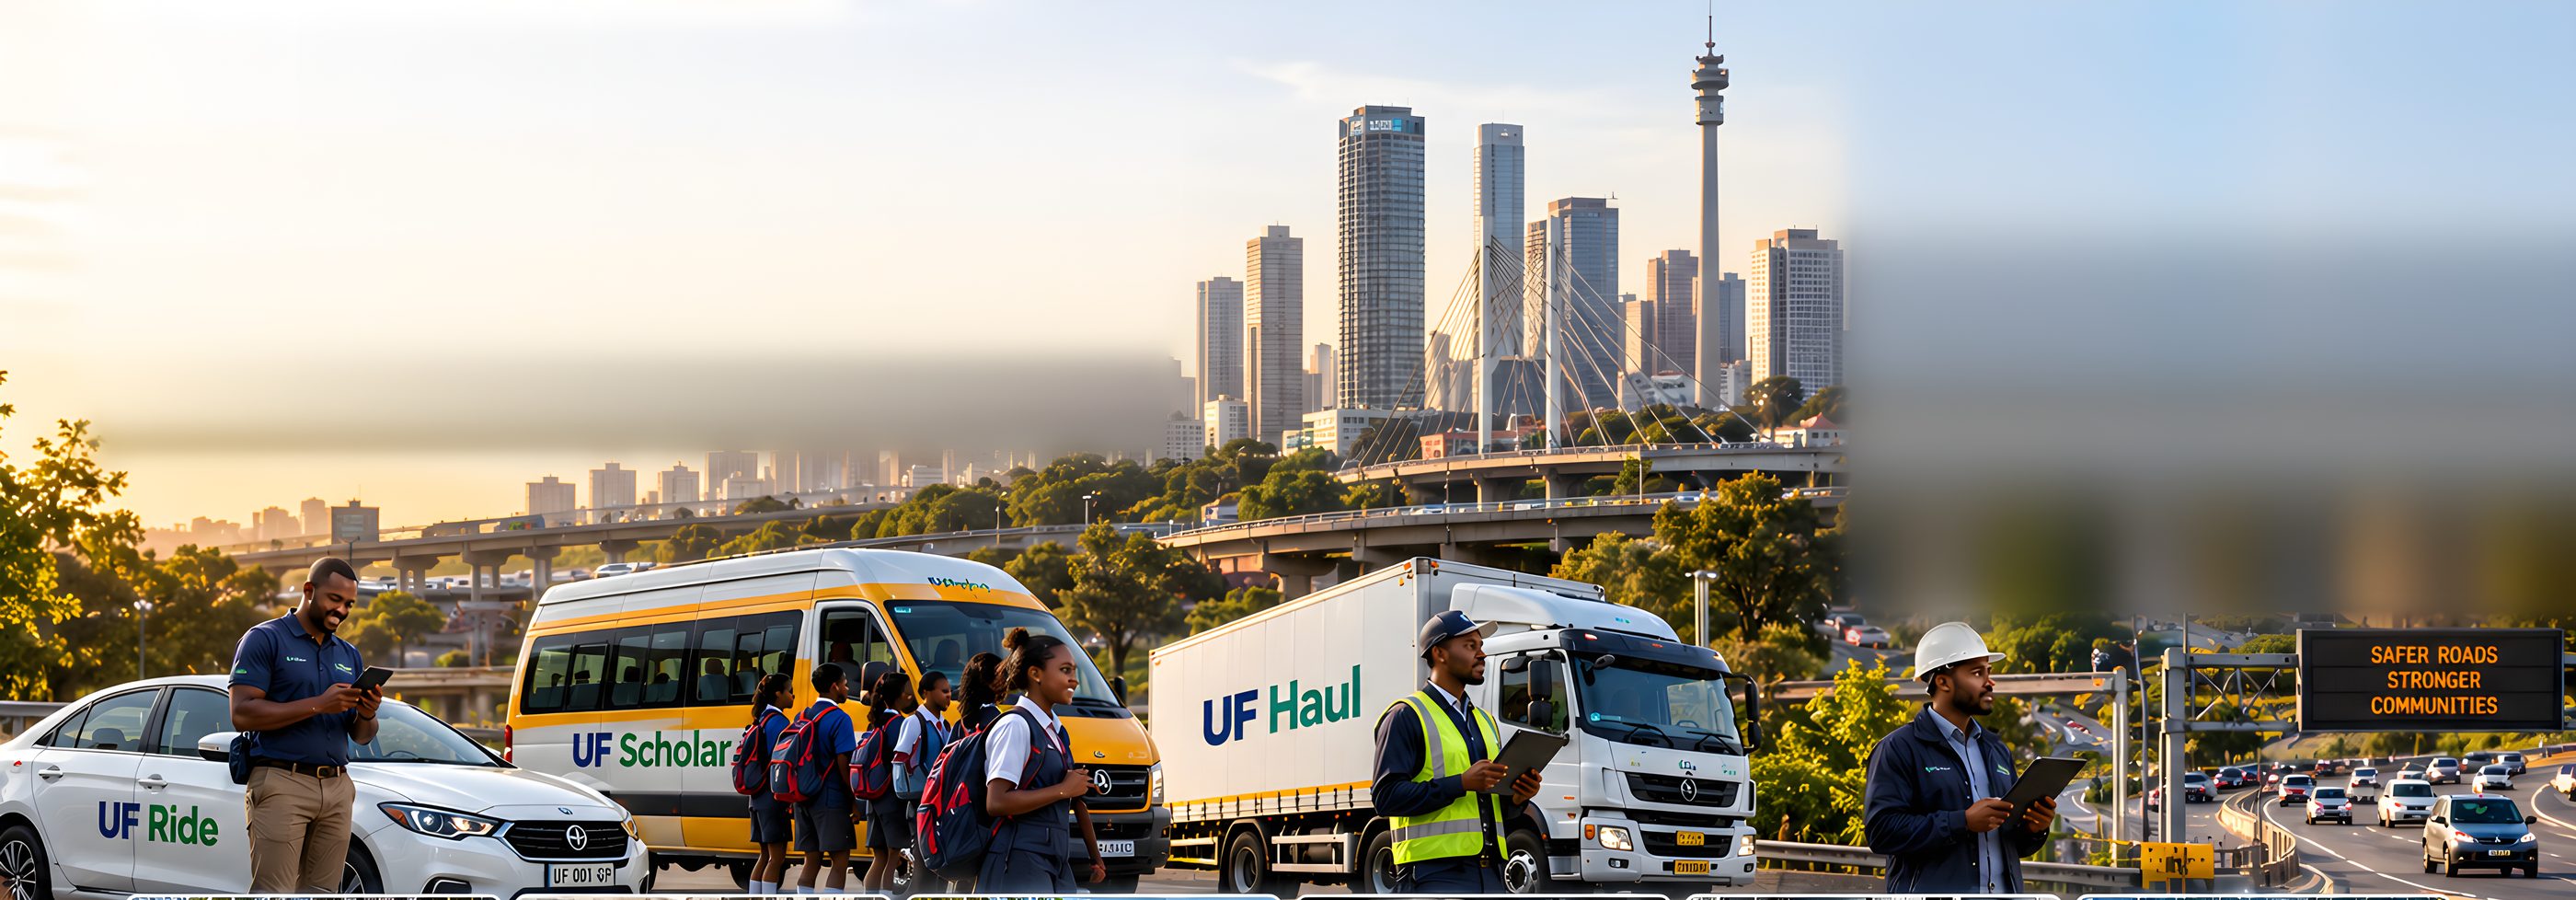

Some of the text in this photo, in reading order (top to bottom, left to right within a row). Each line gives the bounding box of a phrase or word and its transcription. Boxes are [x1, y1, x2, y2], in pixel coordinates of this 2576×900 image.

[2371, 646, 2498, 664] SAFER ROADS
[2387, 671, 2481, 689] STRONGER
[1203, 663, 1362, 746] UF Haul
[2371, 697, 2498, 714] COMMUNITIES
[573, 730, 732, 768] UF Scholar
[98, 801, 218, 846] UF Ride
[554, 868, 569, 883] UF
